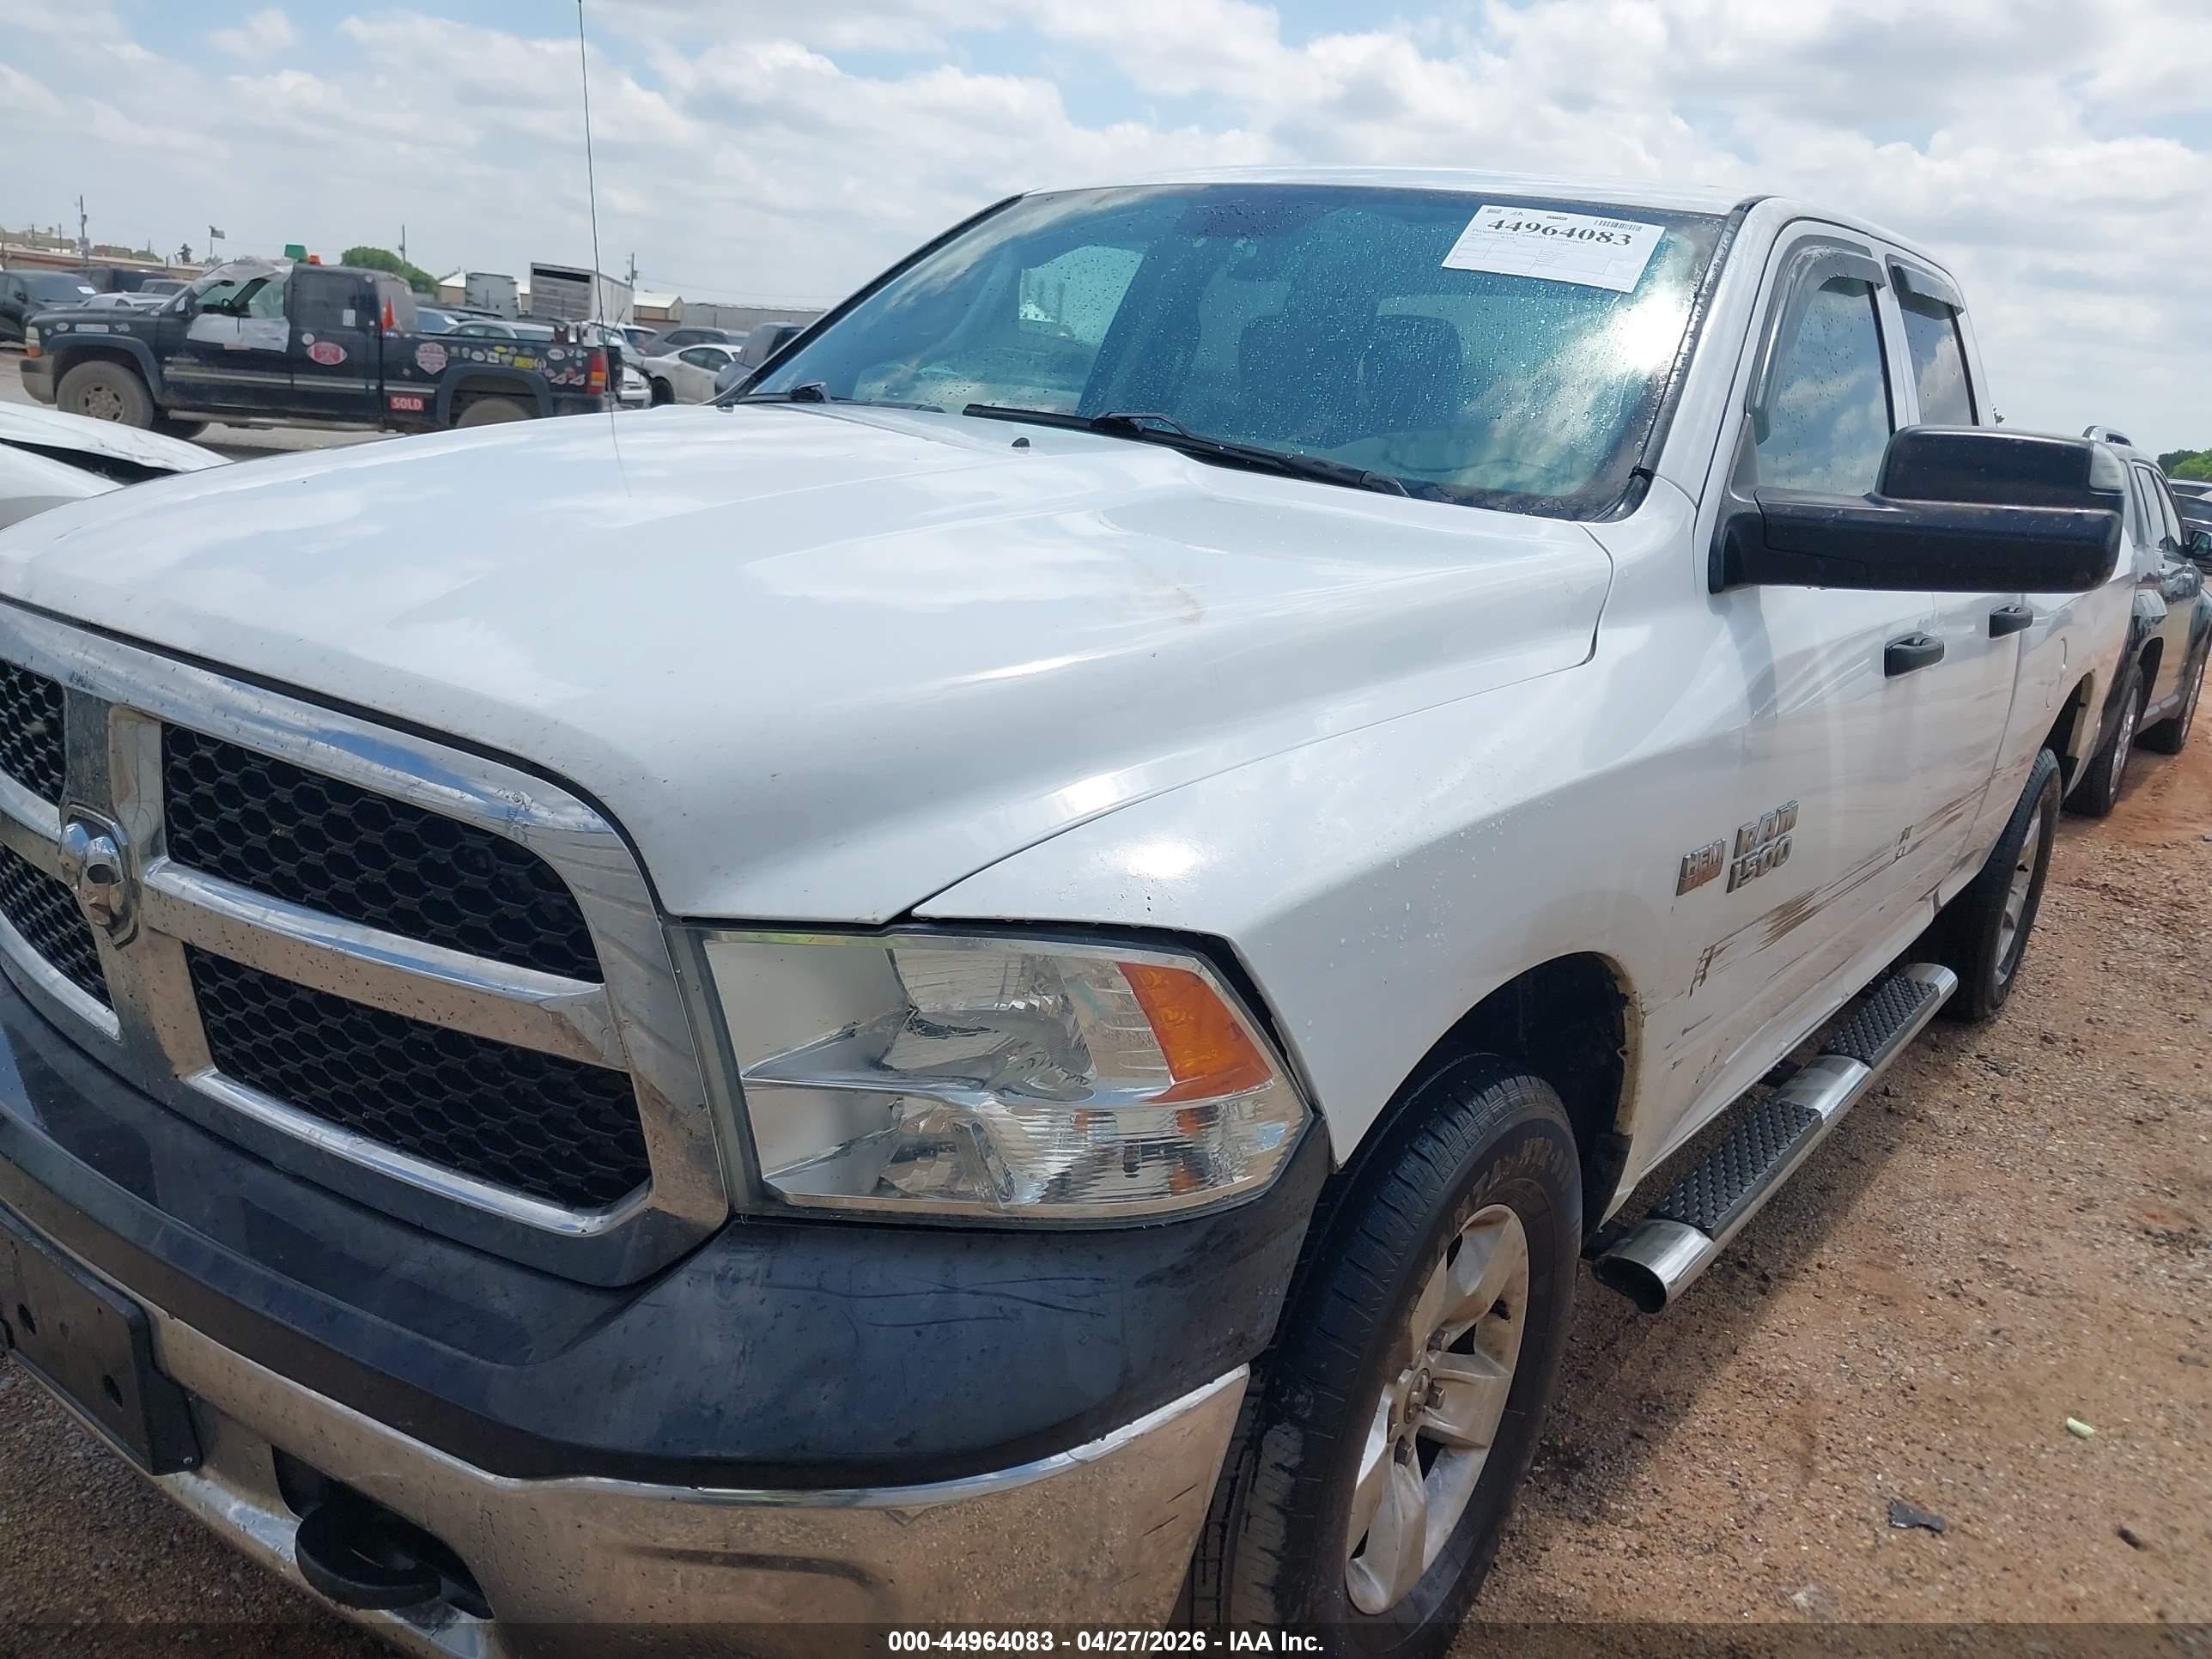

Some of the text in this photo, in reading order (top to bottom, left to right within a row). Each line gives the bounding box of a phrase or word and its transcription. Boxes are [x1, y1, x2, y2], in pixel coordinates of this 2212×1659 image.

[1488, 219, 1632, 246] 44964083
[391, 397, 422, 410] SOLD
[1734, 799, 1799, 859] RAM
[1679, 838, 1726, 884] HEMI
[1727, 835, 1793, 893] 1500
